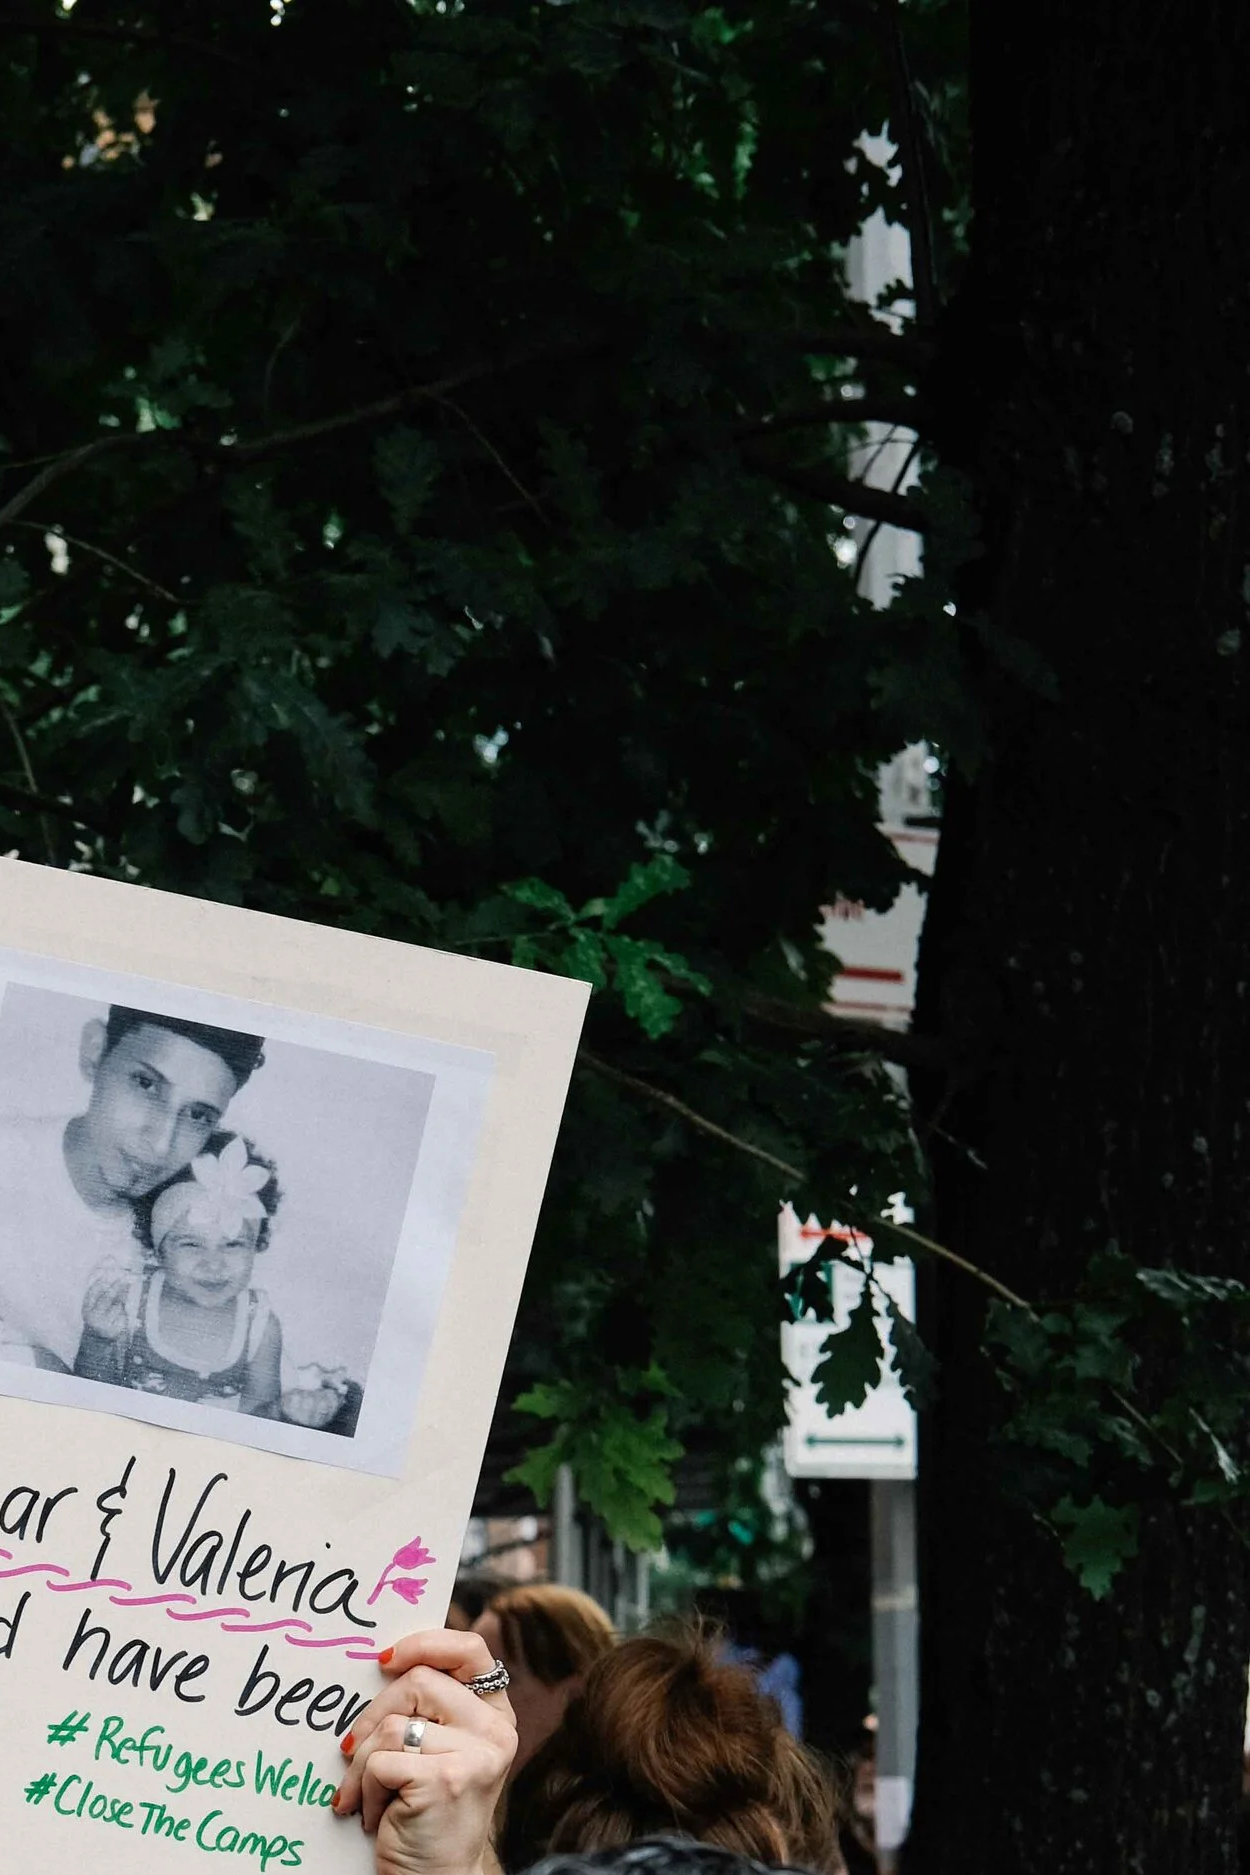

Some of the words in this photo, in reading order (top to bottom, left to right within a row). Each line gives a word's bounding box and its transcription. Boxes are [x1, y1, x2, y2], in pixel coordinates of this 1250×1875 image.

[89, 1454, 137, 1581] &
[151, 1467, 377, 1628] Valeria
[62, 1606, 210, 1704] have
